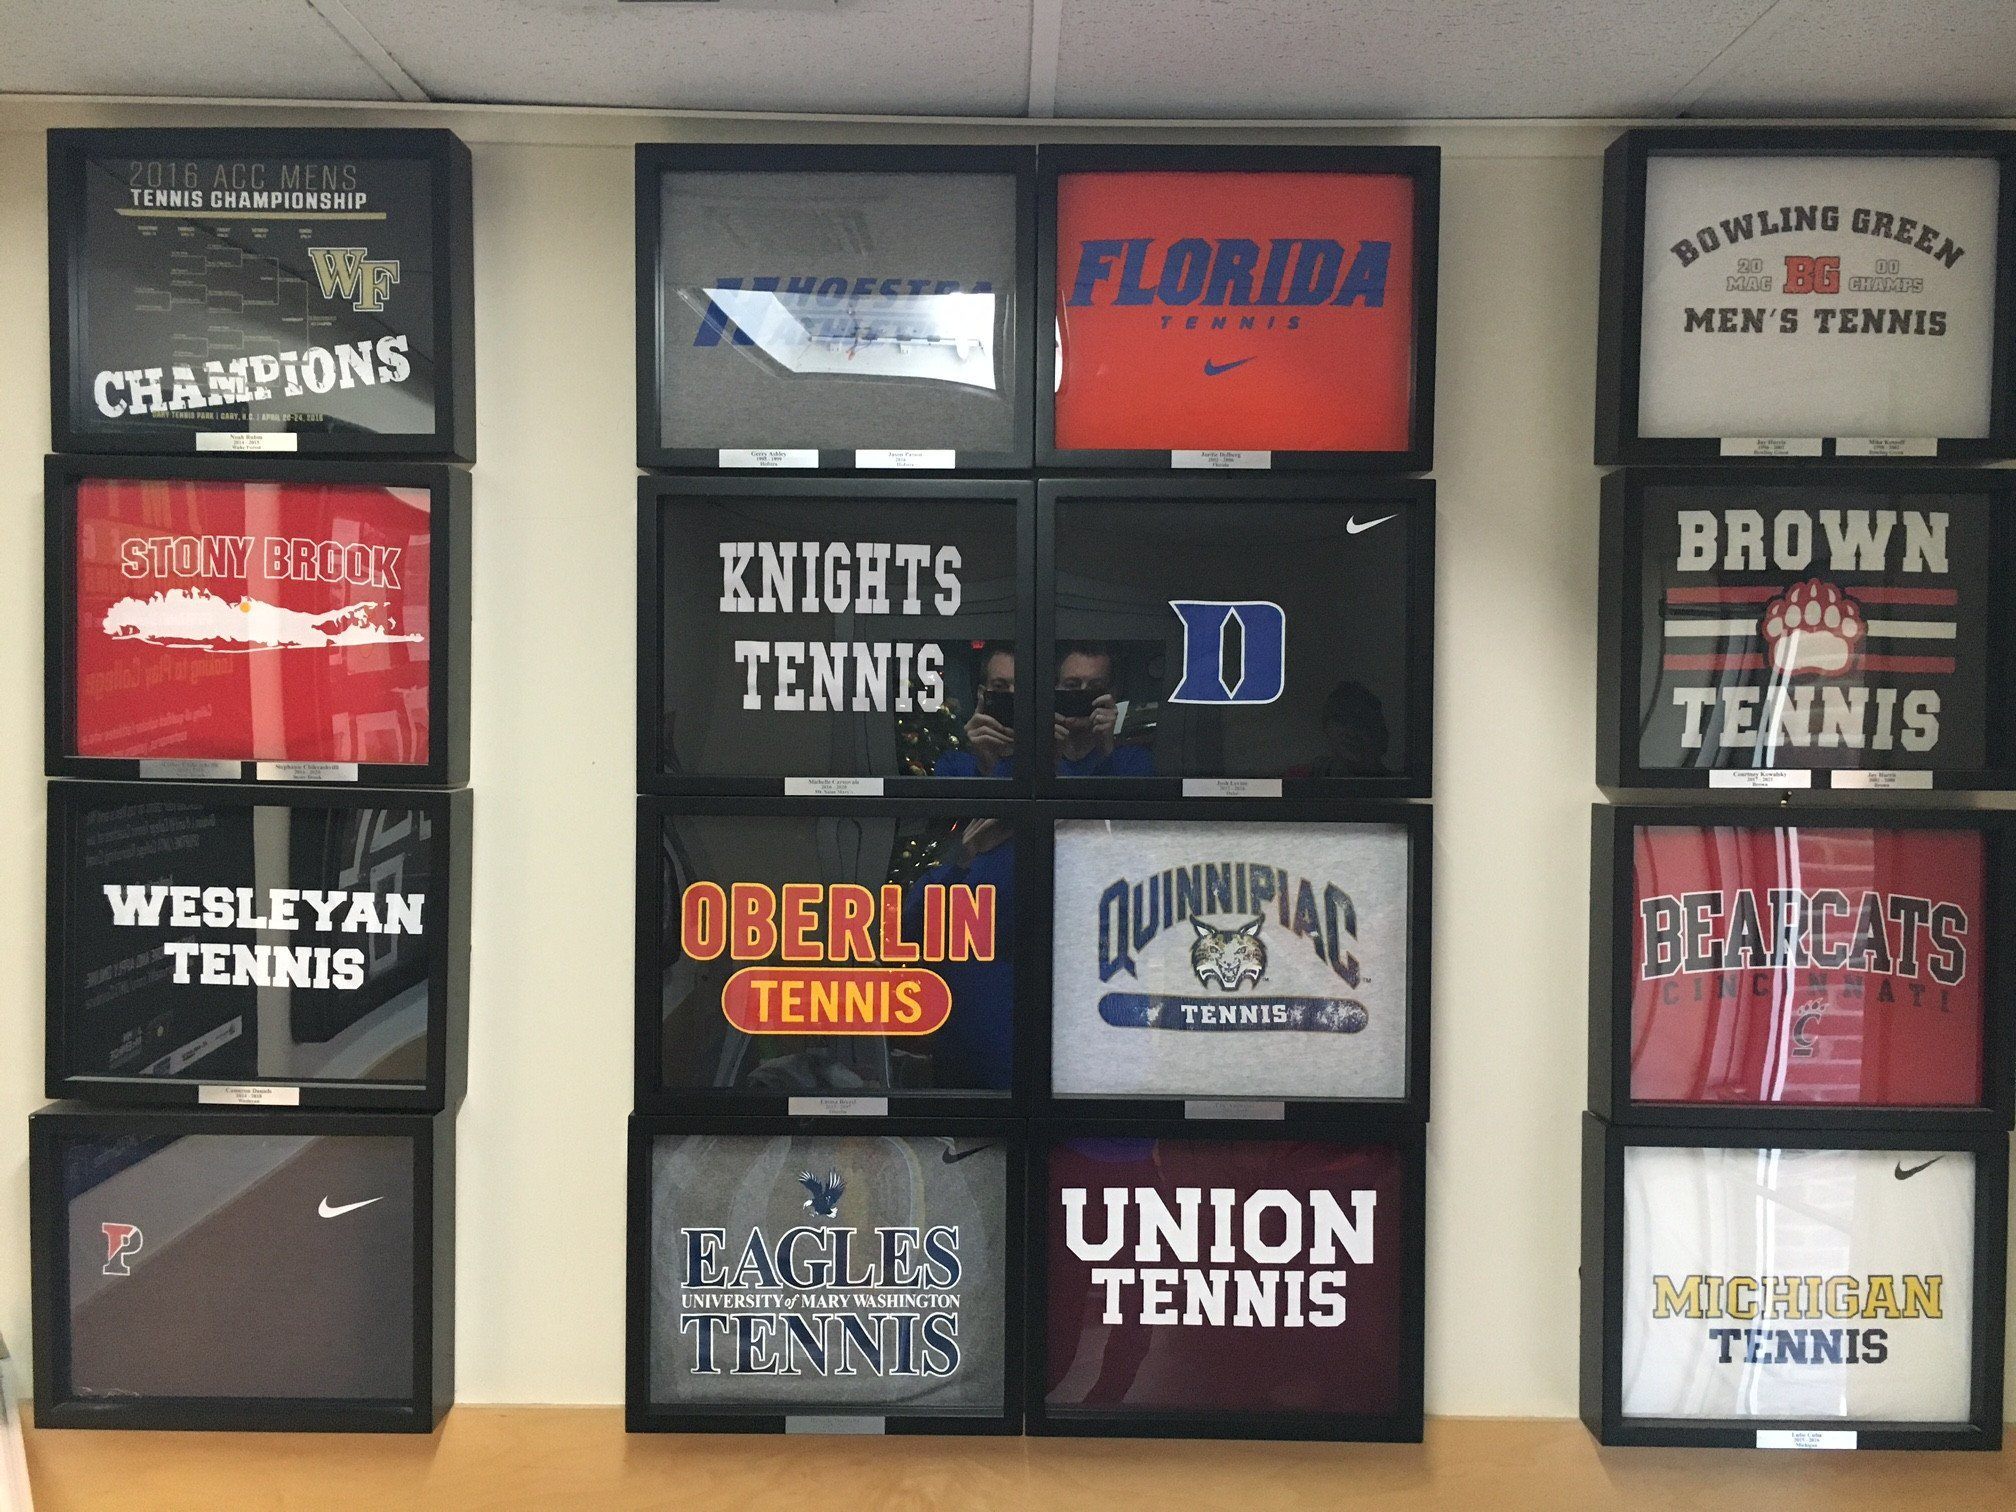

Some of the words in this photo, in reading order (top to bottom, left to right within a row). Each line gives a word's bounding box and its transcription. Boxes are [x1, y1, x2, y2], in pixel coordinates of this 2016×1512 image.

[129, 161, 199, 190] 2016
[213, 163, 266, 190] ACC
[280, 165, 357, 191] MENS
[130, 188, 204, 208] TENNIS
[210, 190, 367, 210] CHAMPIONSHIP
[1670, 205, 1840, 268] BOWLING
[1851, 208, 1966, 269] GREEN
[308, 247, 400, 312] WF
[1067, 237, 1392, 308] FLORIDA
[1726, 276, 1772, 292] MAC
[1737, 258, 1763, 275] 20
[1782, 255, 1841, 295] BG
[1848, 276, 1923, 293] CHAMPS
[1160, 315, 1302, 330] TENNIS
[1684, 307, 1799, 334] MEN'S
[1814, 308, 1948, 336] TENNIS
[94, 335, 412, 418] CHAMPIONS
[121, 535, 255, 580] STONY
[264, 537, 402, 590] BROOK
[1677, 509, 1949, 573] BROWN
[719, 541, 962, 616] KNIGHTS
[734, 640, 945, 713] TENNIS
[1167, 600, 1286, 705] D
[1672, 686, 1941, 752] TENNIS
[103, 884, 425, 934] WESLEYAN
[680, 881, 996, 962] OBERLIN
[1098, 861, 1361, 990] QUINNIPIAC
[1640, 888, 1968, 986] BEARCATS
[163, 942, 365, 990] TENNIS
[1662, 973, 1951, 1013] CINCNNATI
[750, 980, 922, 1024] TENNIS
[1180, 1004, 1288, 1024] TENNIS
[101, 1222, 144, 1276] P
[1061, 1187, 1377, 1264] UNION
[681, 1226, 962, 1290] EAGLES
[681, 1294, 783, 1308] UNIVERSITY
[784, 1293, 800, 1310] of
[801, 1294, 850, 1309] MARY
[853, 1294, 961, 1309] WASHINGTON
[1091, 1268, 1347, 1327] TENNIS
[1653, 1274, 1943, 1320] MICHIGAN
[681, 1312, 961, 1377] TENNIS
[1709, 1328, 1888, 1364] TENNIS
